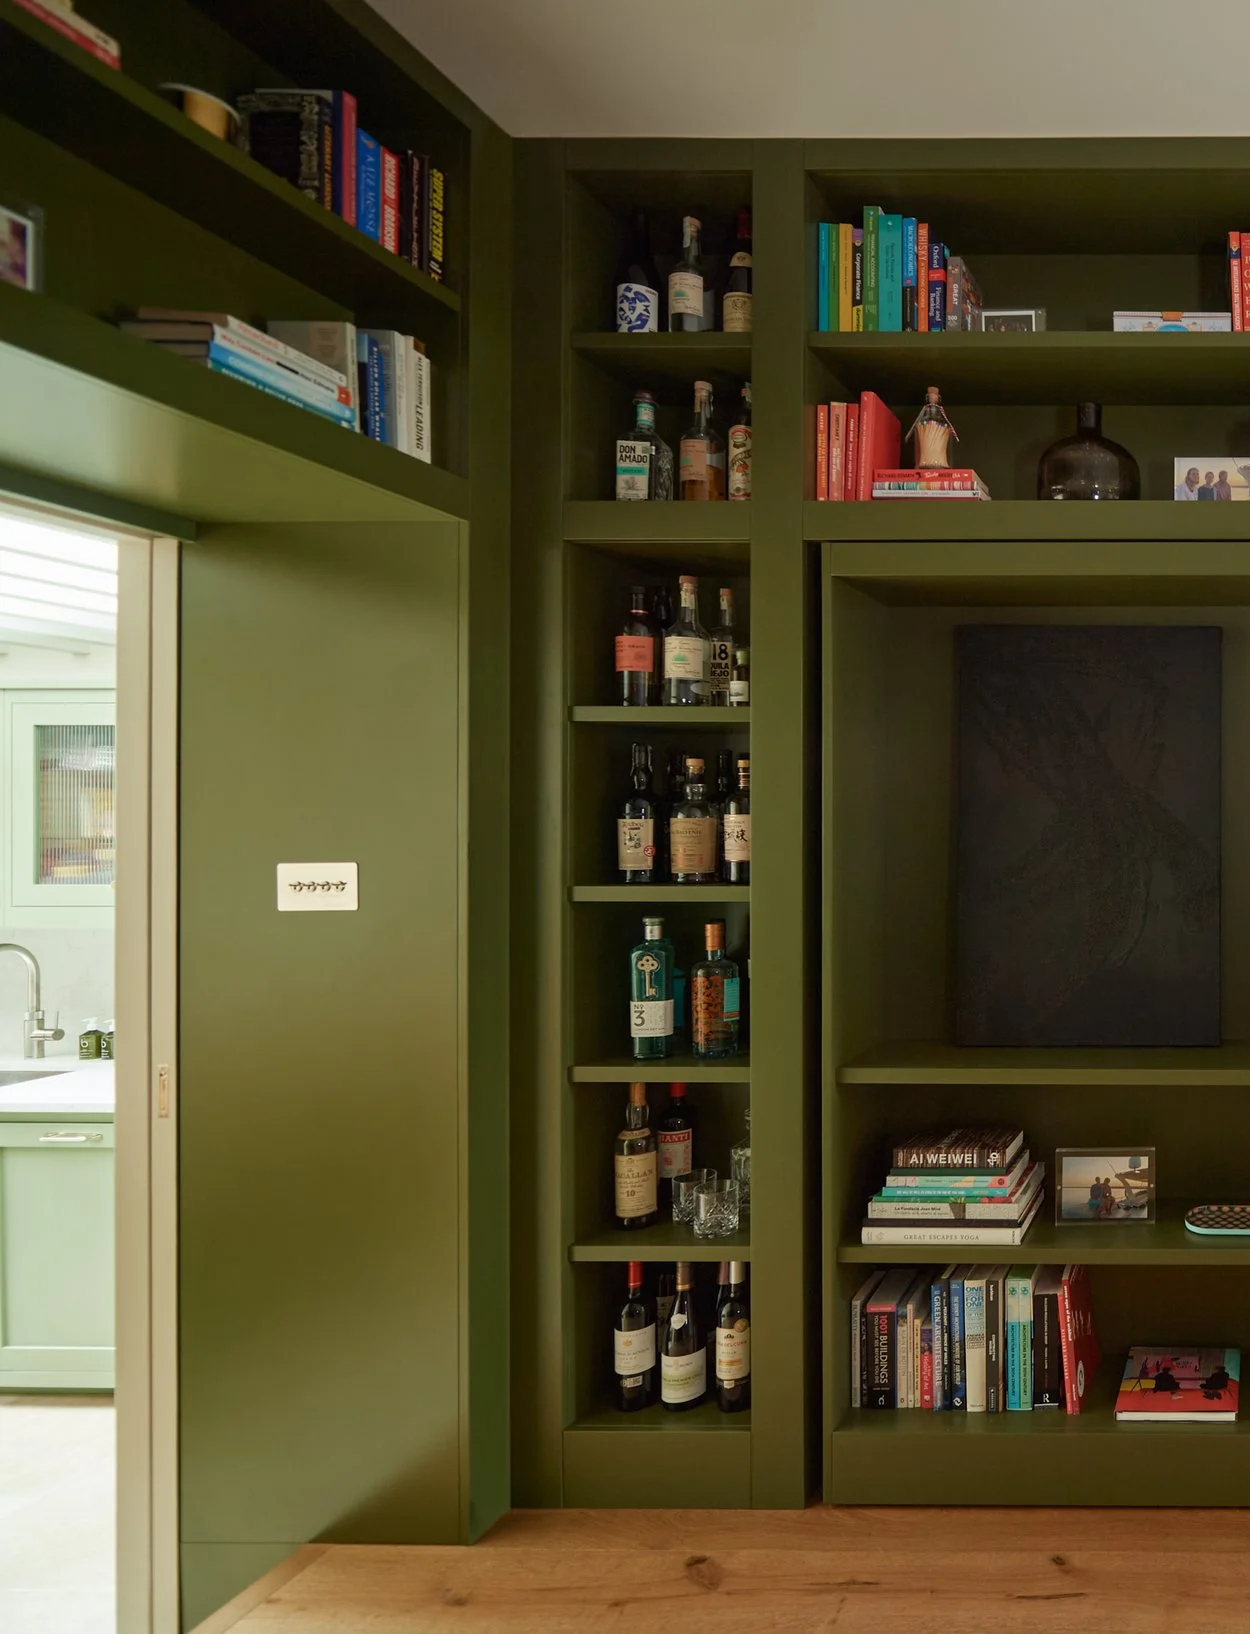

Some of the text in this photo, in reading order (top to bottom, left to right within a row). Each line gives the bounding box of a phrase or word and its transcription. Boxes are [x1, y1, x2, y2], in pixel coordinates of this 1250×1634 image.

[384, 153, 396, 199] RICHARD
[431, 168, 444, 263] SUPER SYSTEM
[918, 229, 928, 261] WHISKY
[853, 252, 862, 279] Corporate
[929, 293, 937, 316] Banking
[415, 404, 424, 450] LEADING
[618, 454, 648, 464] AMADO
[619, 445, 636, 454] DON
[712, 644, 729, 660] 18
[633, 1010, 645, 1027] 3
[910, 1153, 977, 1164] AI WEIWEI
[880, 1314, 888, 1384] 1001 BUILDINGS
[934, 1296, 942, 1386] GREEN ARCHITECTURE
